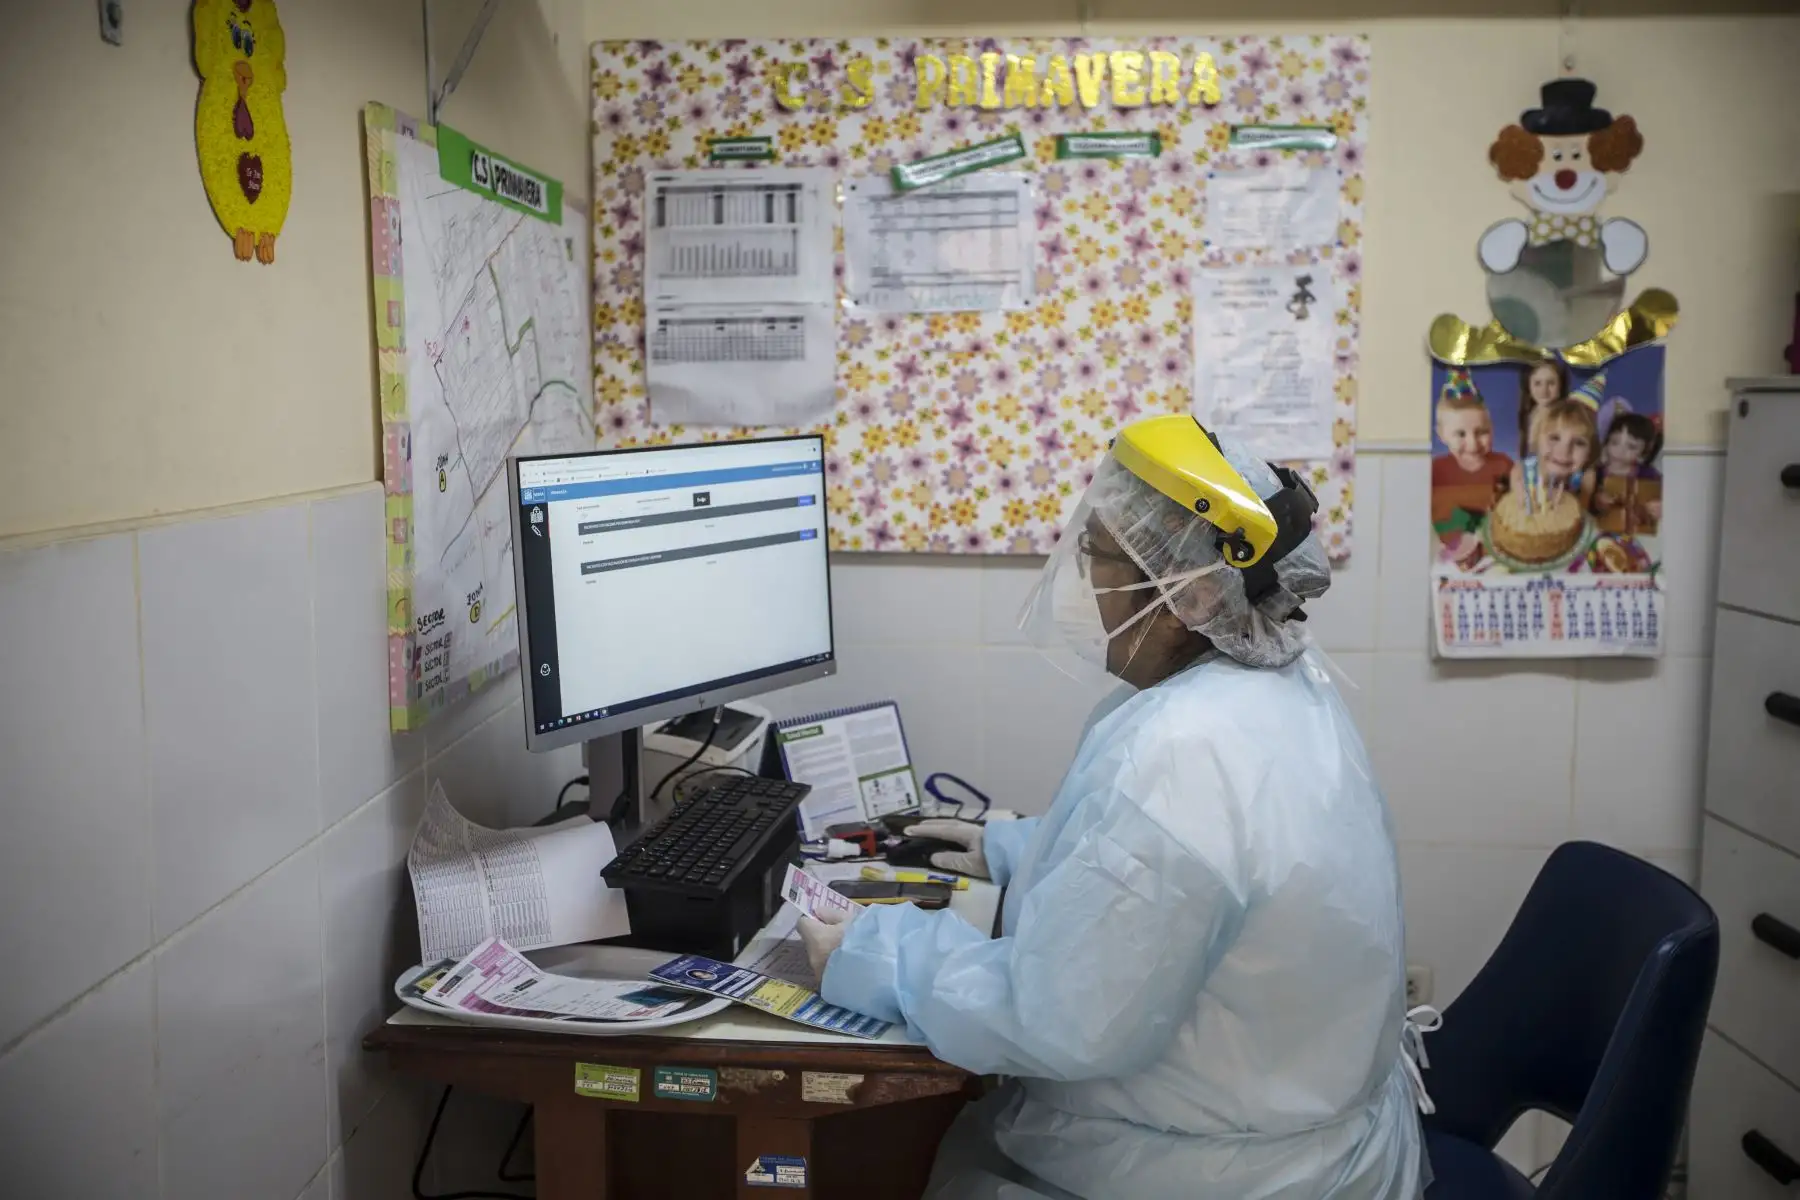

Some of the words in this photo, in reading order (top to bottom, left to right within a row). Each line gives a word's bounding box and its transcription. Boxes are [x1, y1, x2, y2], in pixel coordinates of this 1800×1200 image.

[837, 54, 874, 107] S
[913, 51, 1222, 108] PRIMAVERA
[494, 163, 542, 208] PRIMAVERA
[417, 607, 446, 632] SECTOR
